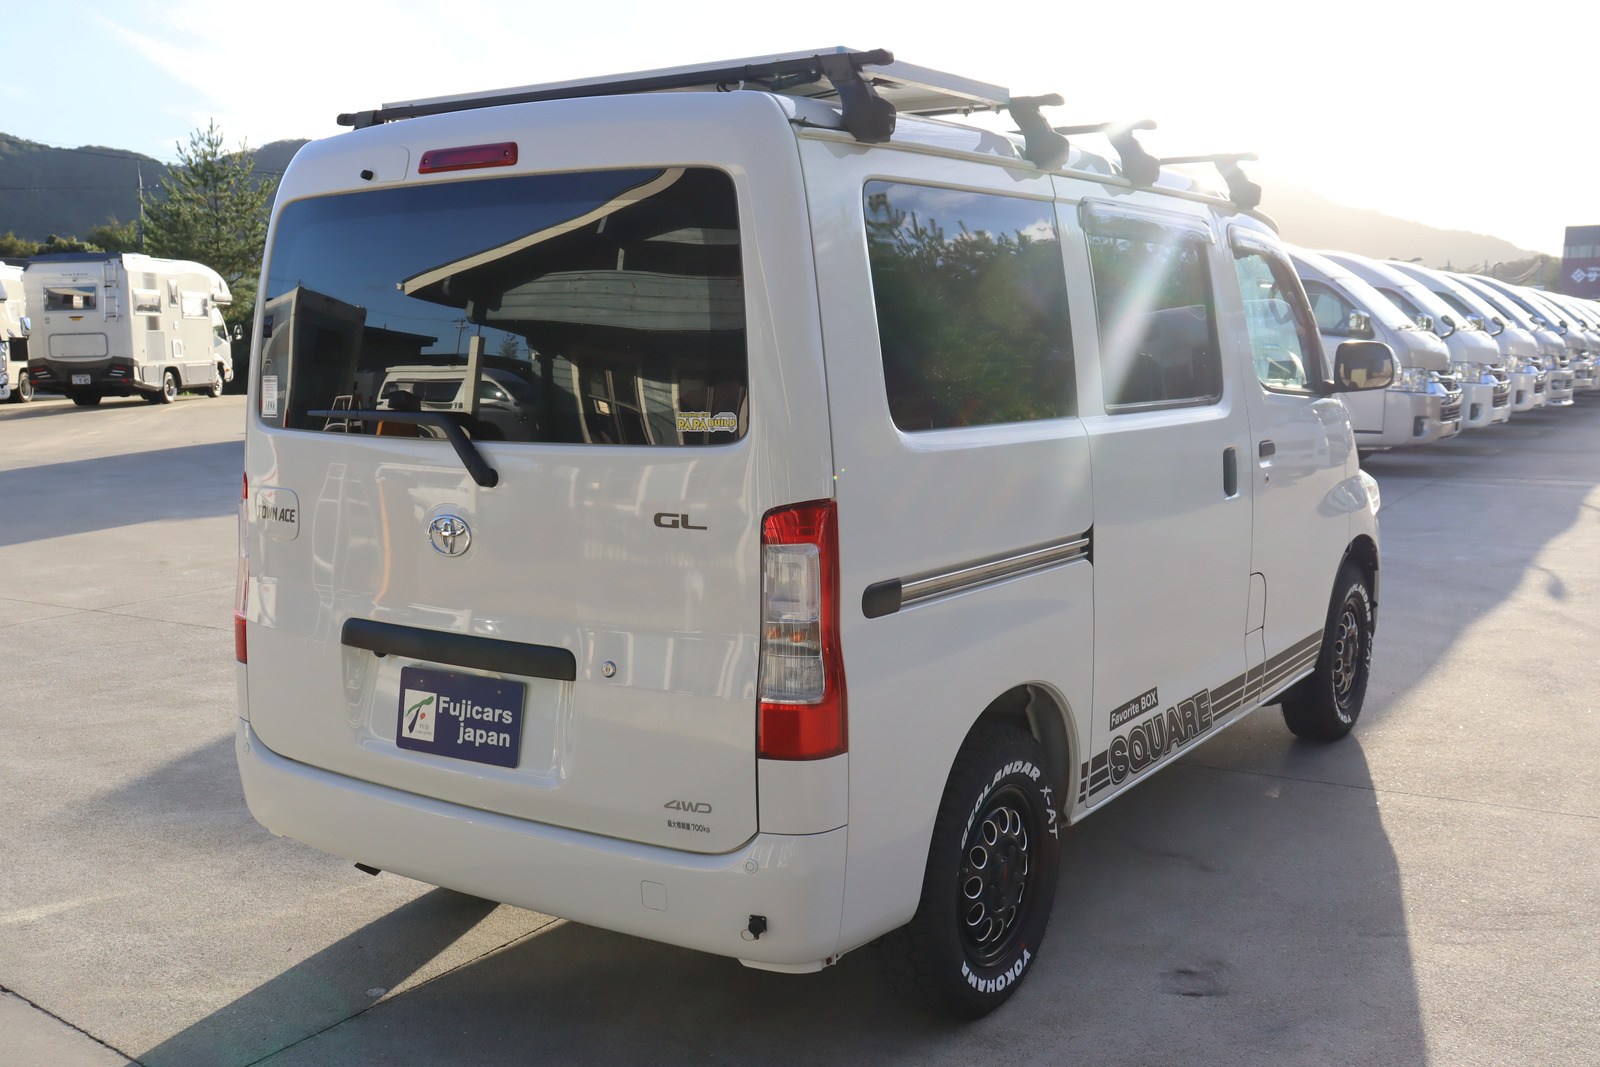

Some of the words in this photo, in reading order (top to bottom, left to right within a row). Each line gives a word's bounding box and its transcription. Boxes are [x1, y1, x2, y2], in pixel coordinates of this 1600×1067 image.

[677, 418, 708, 430] PAPA
[708, 419, 736, 427] BUILD
[257, 504, 278, 521] TOWN
[278, 508, 296, 523] ACE
[653, 512, 708, 530] GL
[438, 696, 513, 724] Fujicars
[1110, 703, 1140, 727] Favorite
[1140, 690, 1158, 711] BOX
[457, 722, 511, 748] japan
[1108, 688, 1213, 785] SQUARE
[663, 799, 712, 814] 4WD
[961, 760, 1041, 850] GEOLANDAR
[1040, 785, 1060, 840] X-AT
[961, 949, 1032, 993] YOKOHAMA
